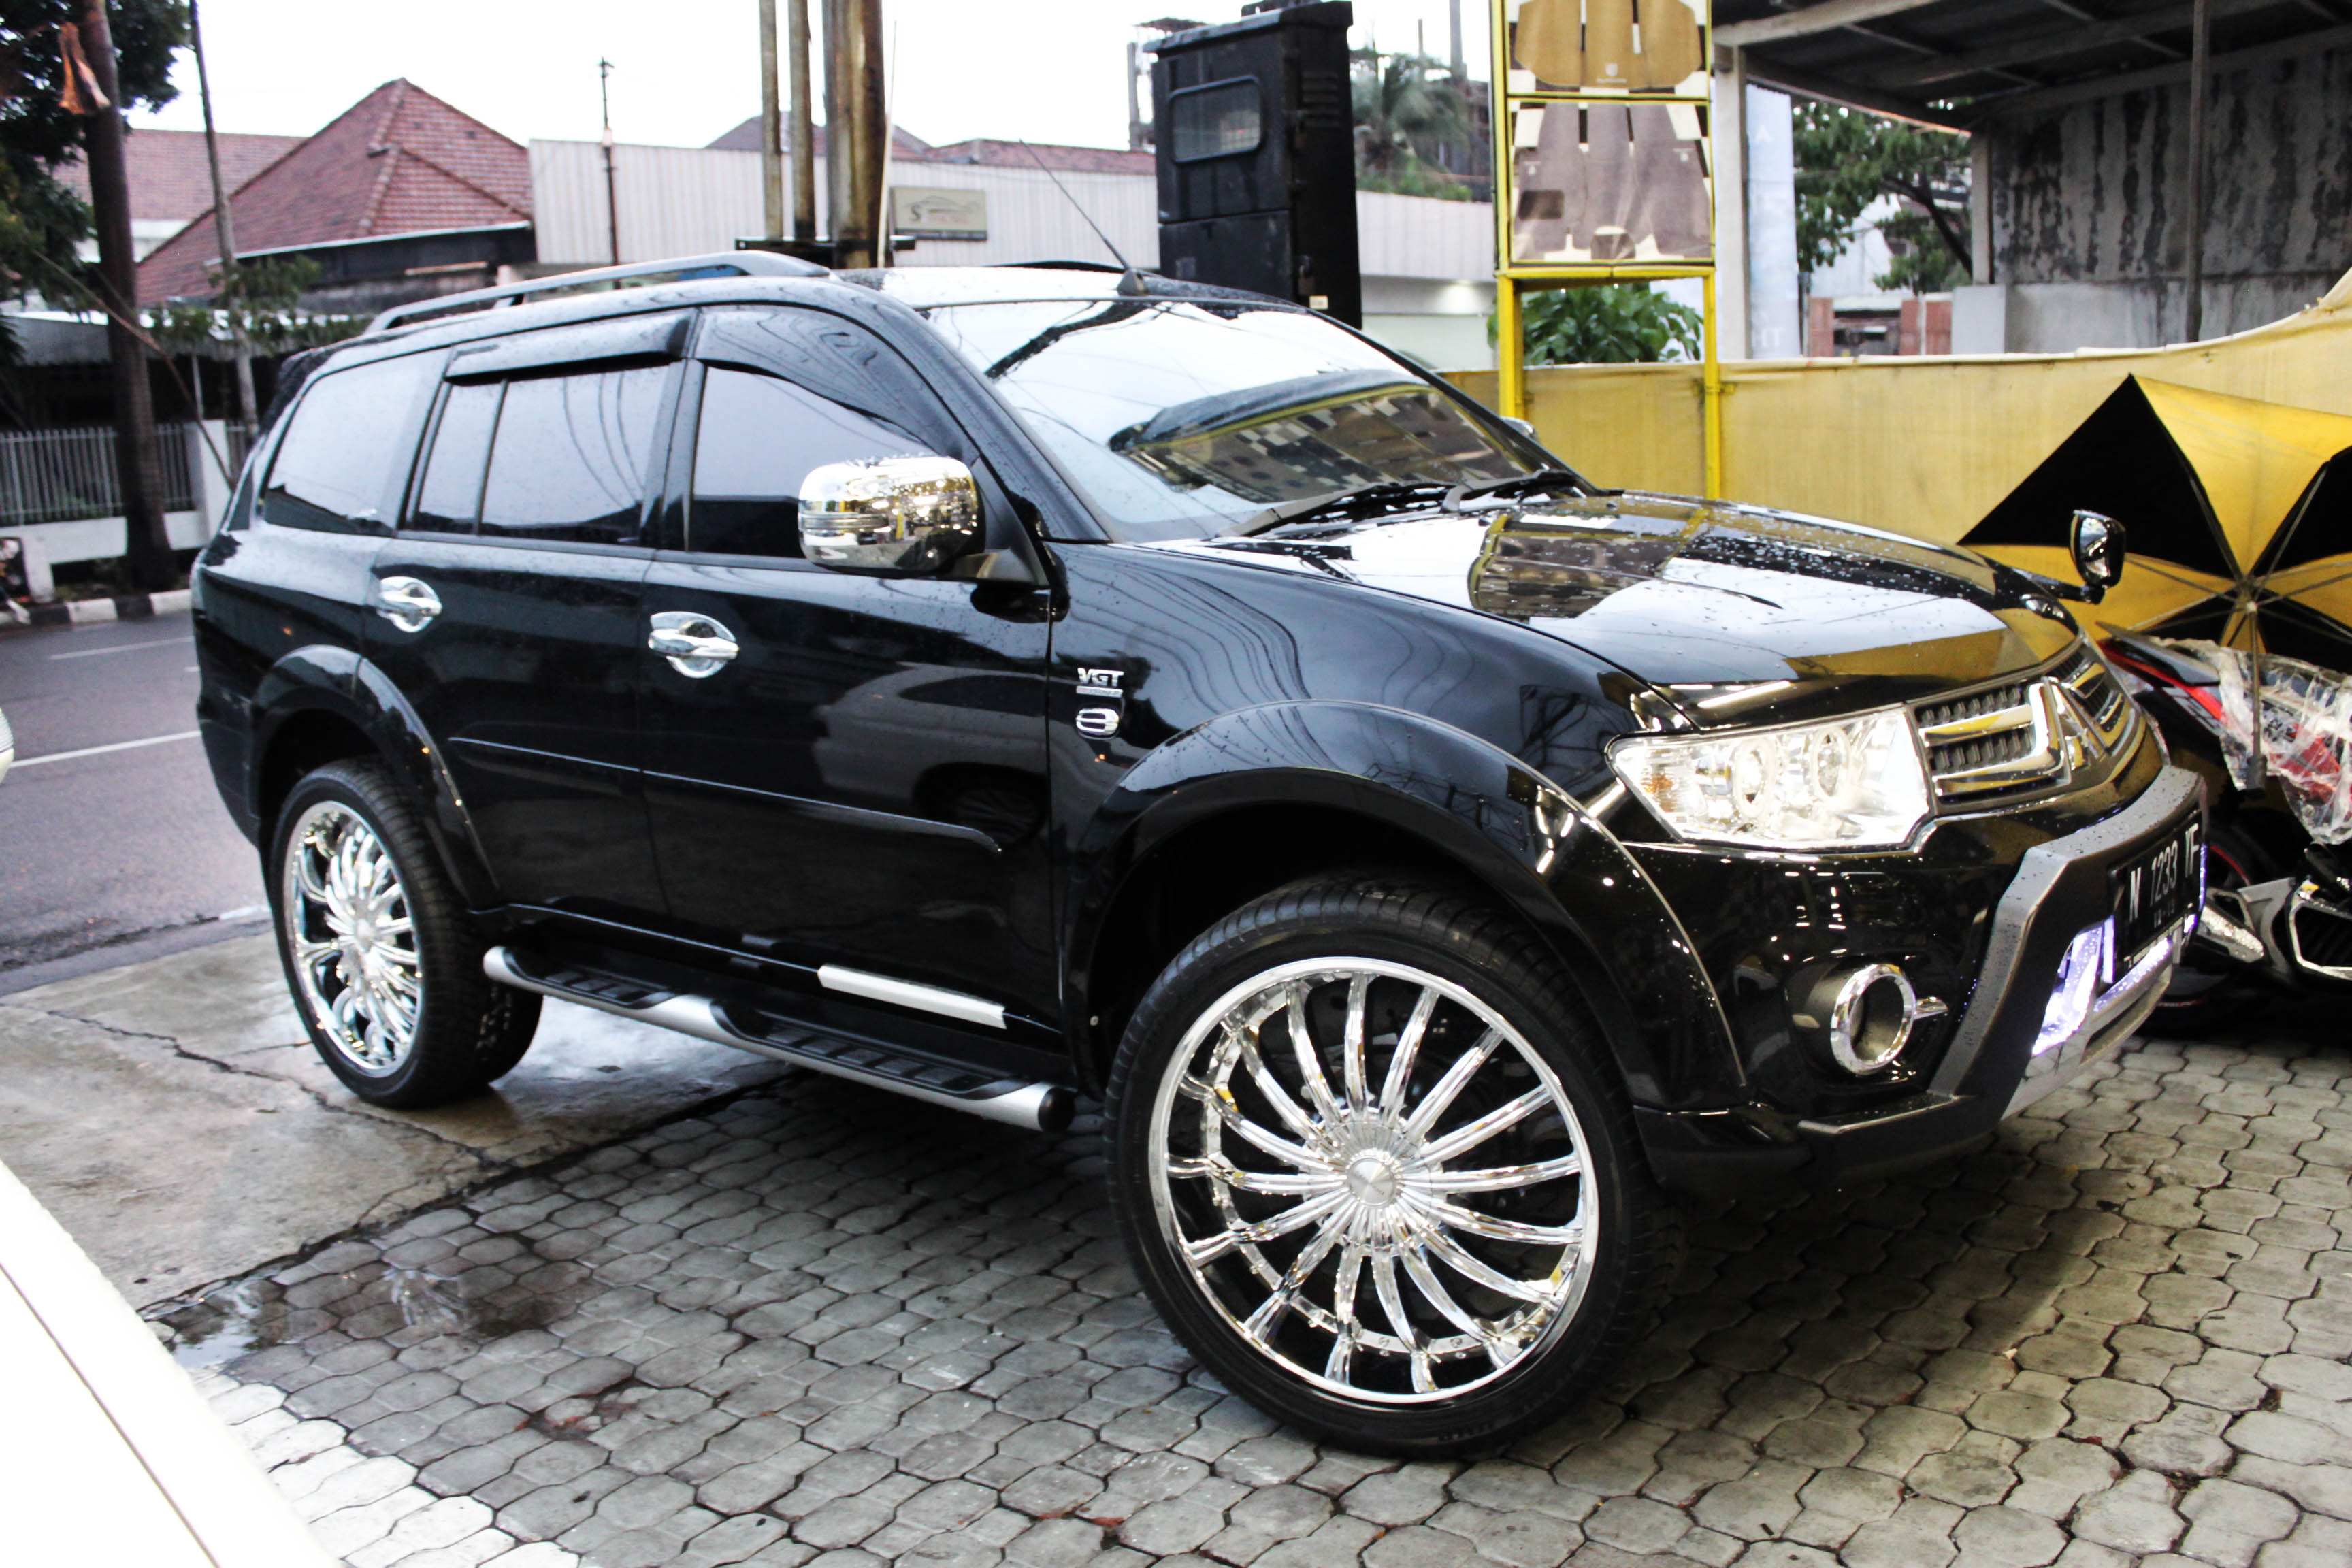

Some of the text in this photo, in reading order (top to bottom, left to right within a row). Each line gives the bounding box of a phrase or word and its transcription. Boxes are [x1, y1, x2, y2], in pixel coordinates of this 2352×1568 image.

[1077, 668, 1124, 687] VGT
[2130, 866, 2142, 923] N
[2150, 840, 2178, 907] 1233
